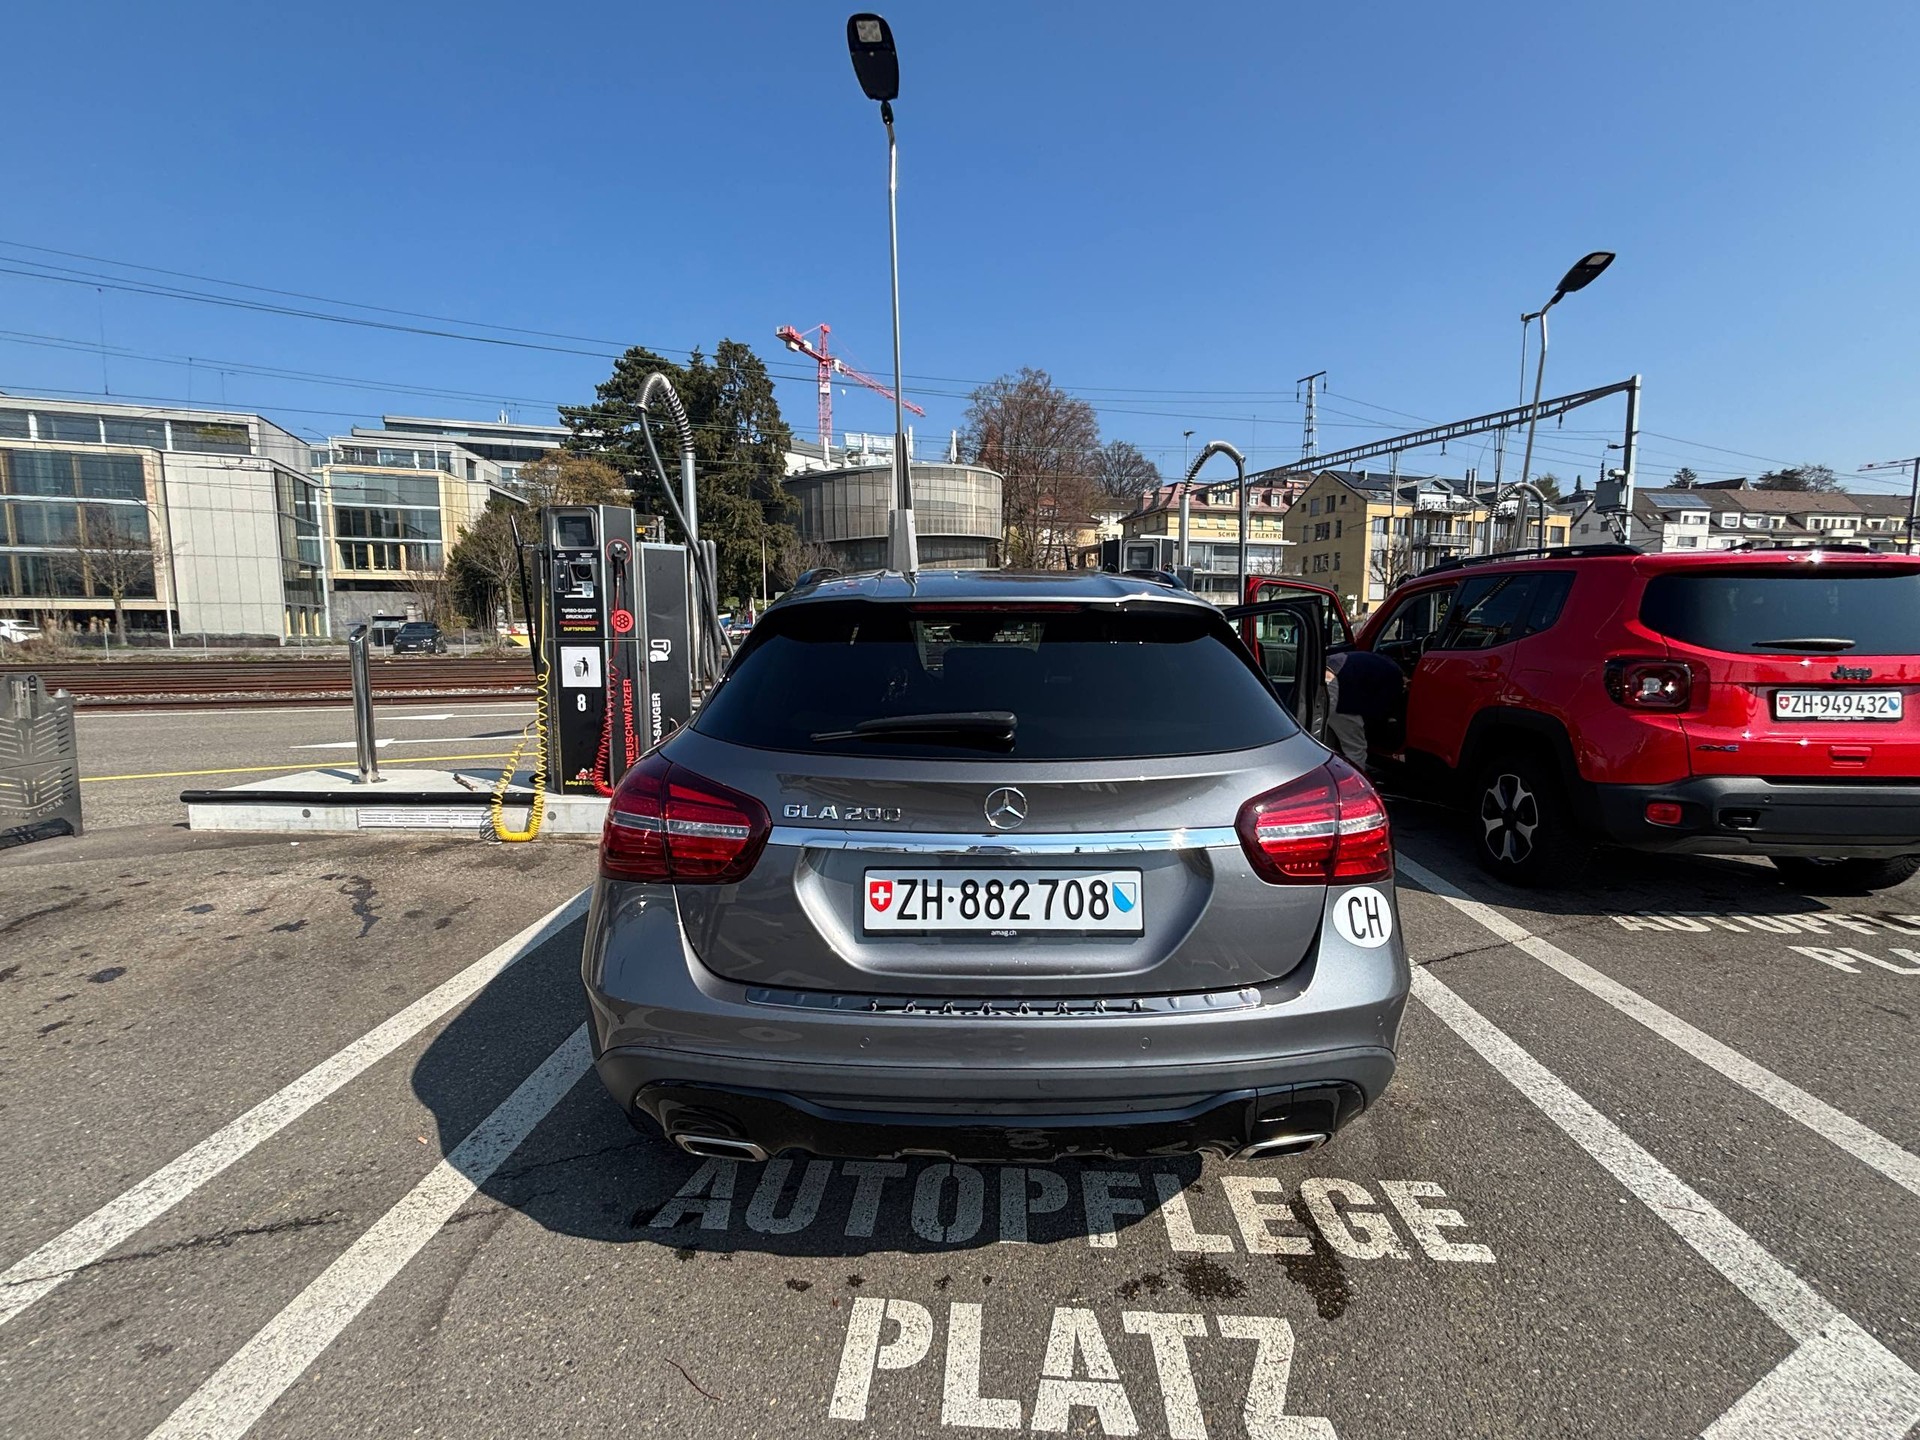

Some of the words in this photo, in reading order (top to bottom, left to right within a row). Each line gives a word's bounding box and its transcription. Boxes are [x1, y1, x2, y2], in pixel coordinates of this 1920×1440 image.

[1255, 532, 1281, 540] ELEKTRO
[1830, 665, 1873, 681] Jeep
[577, 693, 587, 712] 8
[783, 804, 838, 820] GLA
[844, 807, 902, 822] 200
[1347, 896, 1385, 940] CH
[990, 929, 1017, 937] amag.ch
[648, 1159, 1497, 1264] AUTOPFLEGE
[827, 1296, 1340, 1440] PLATZ
